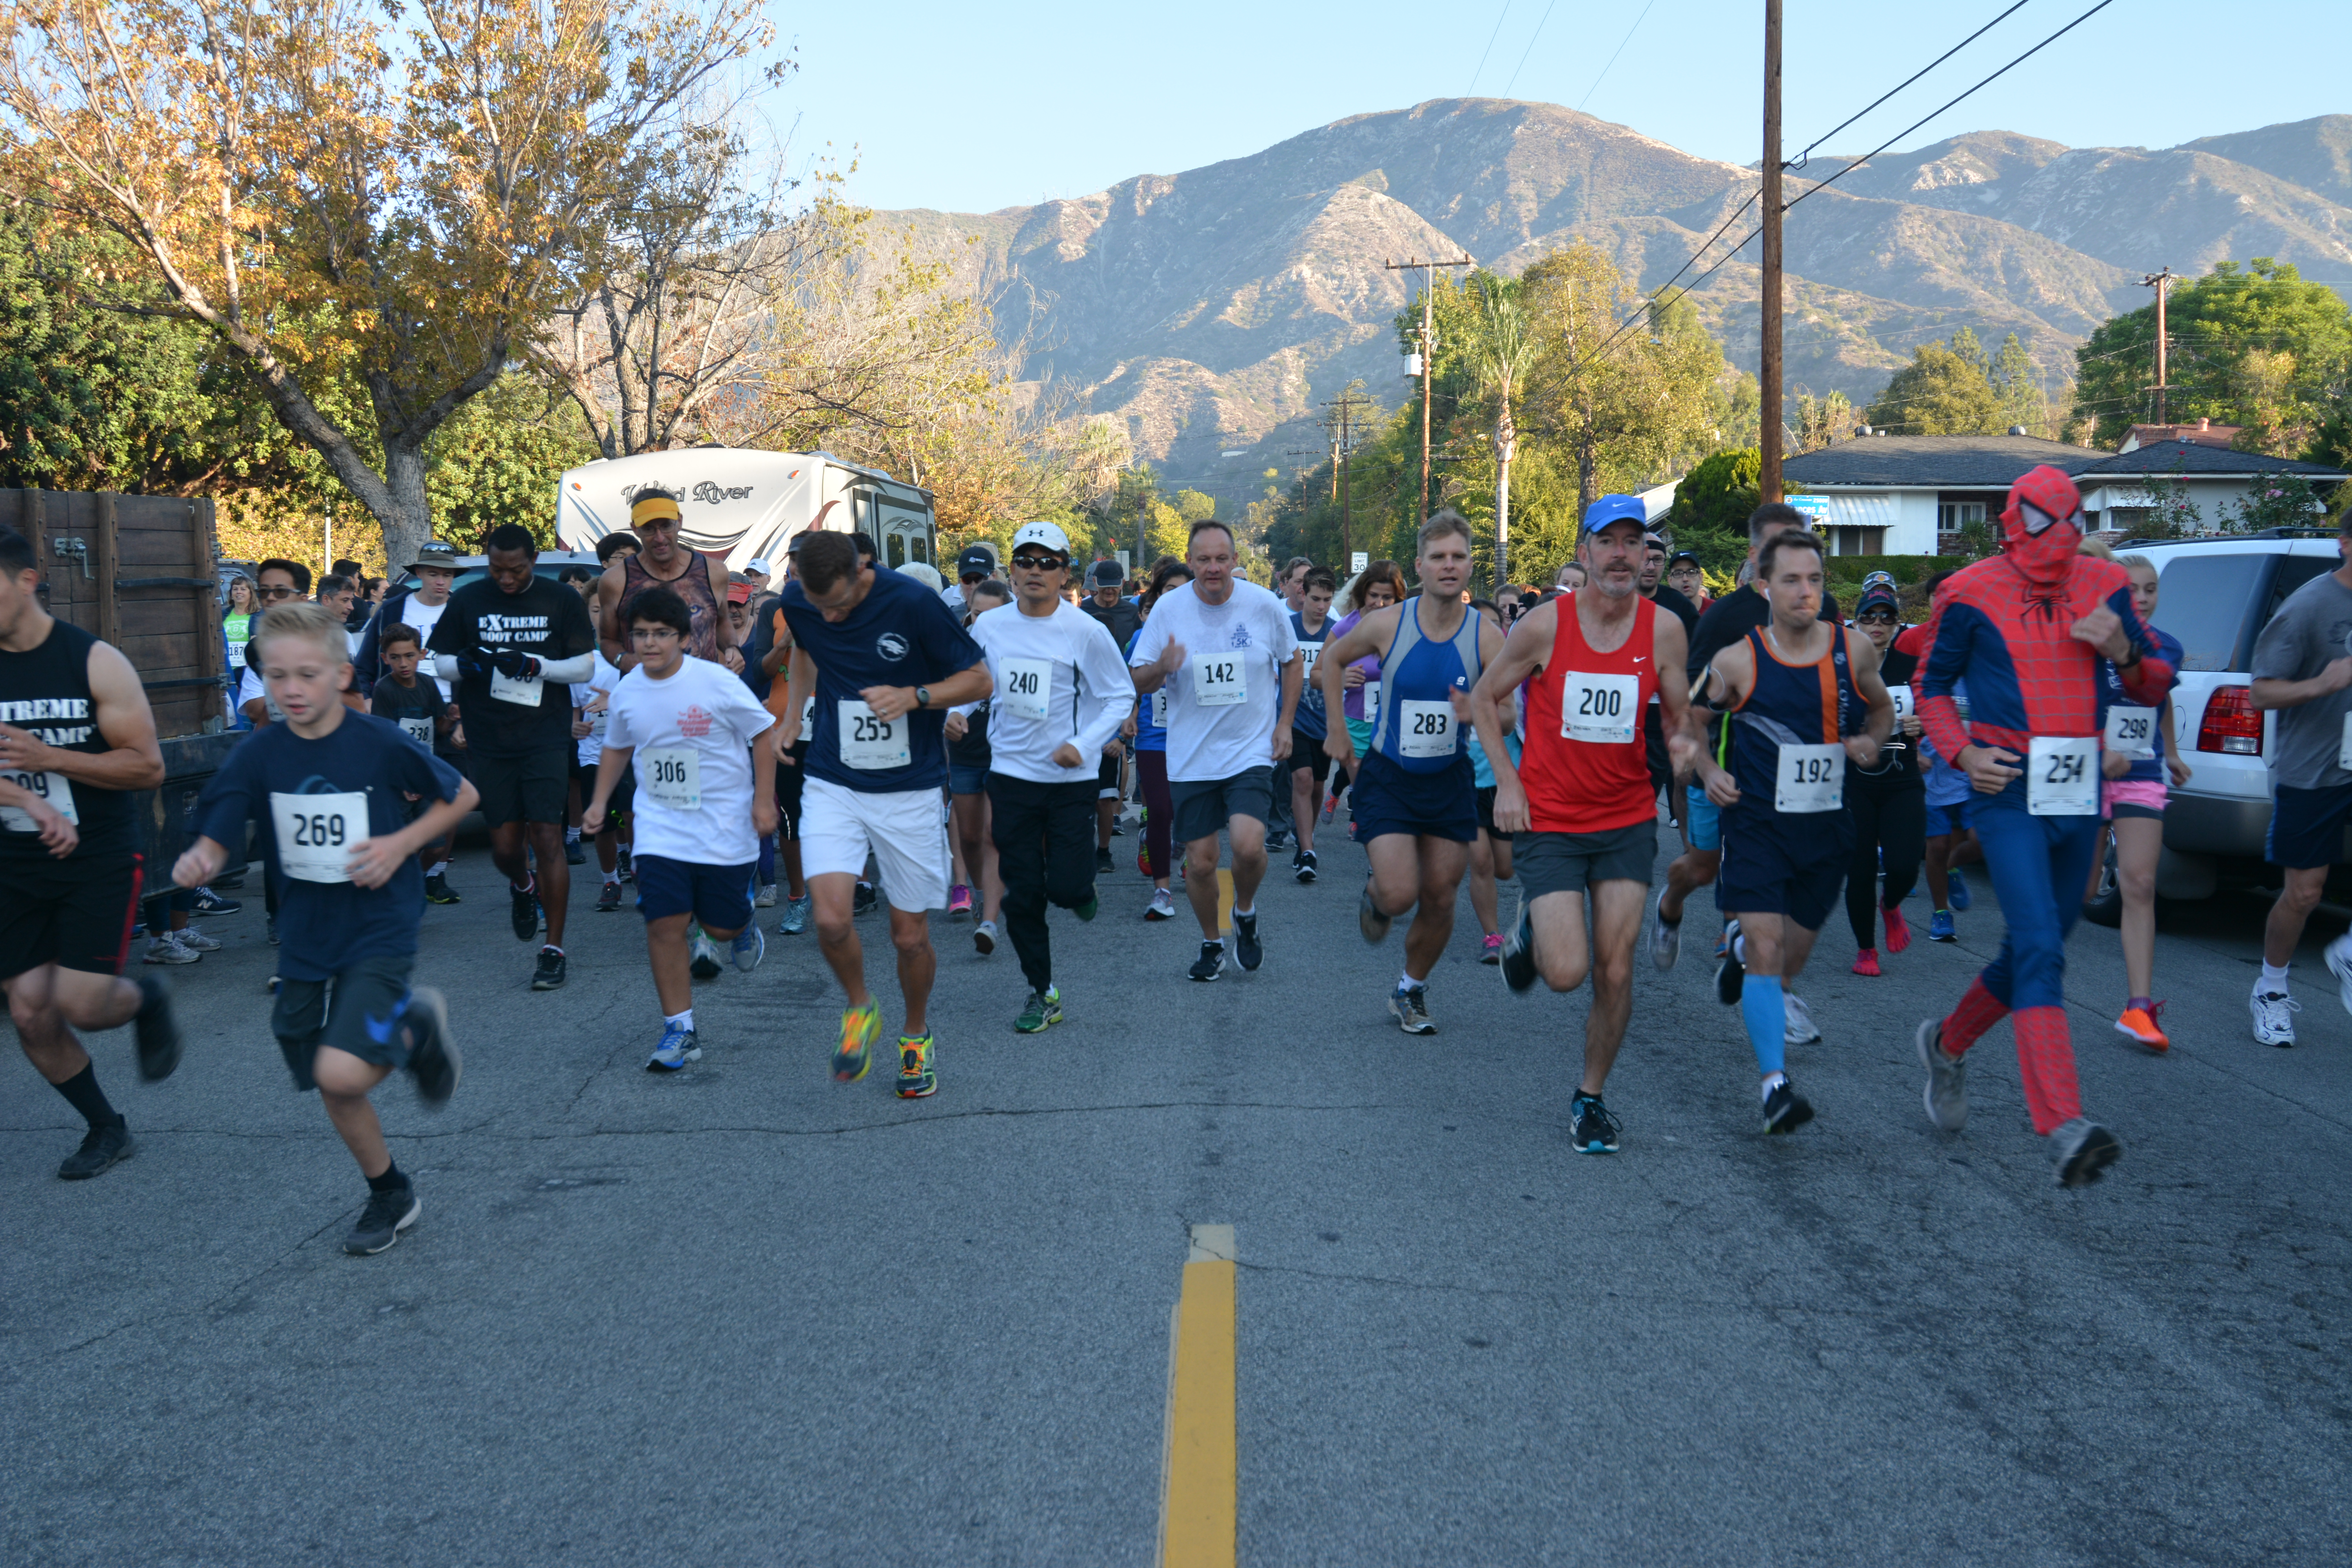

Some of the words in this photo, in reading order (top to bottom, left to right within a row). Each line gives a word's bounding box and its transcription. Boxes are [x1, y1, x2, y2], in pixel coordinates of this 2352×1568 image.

[621, 481, 685, 506] Wd
[692, 481, 753, 504] River
[478, 614, 548, 632] EXTREME
[479, 631, 512, 642] BOOT
[514, 631, 549, 642] CAMP
[1236, 637, 1248, 646] 5K
[229, 646, 244, 656] 187
[1009, 671, 1038, 694] 240
[1205, 662, 1234, 683] 142
[1579, 688, 1621, 717] 200
[853, 716, 892, 741] 255
[1414, 713, 1447, 735] 283
[2118, 718, 2148, 739] 298
[654, 760, 686, 782] 306
[1795, 758, 1832, 783] 192
[2046, 755, 2085, 783] 254
[292, 813, 345, 846] 269
